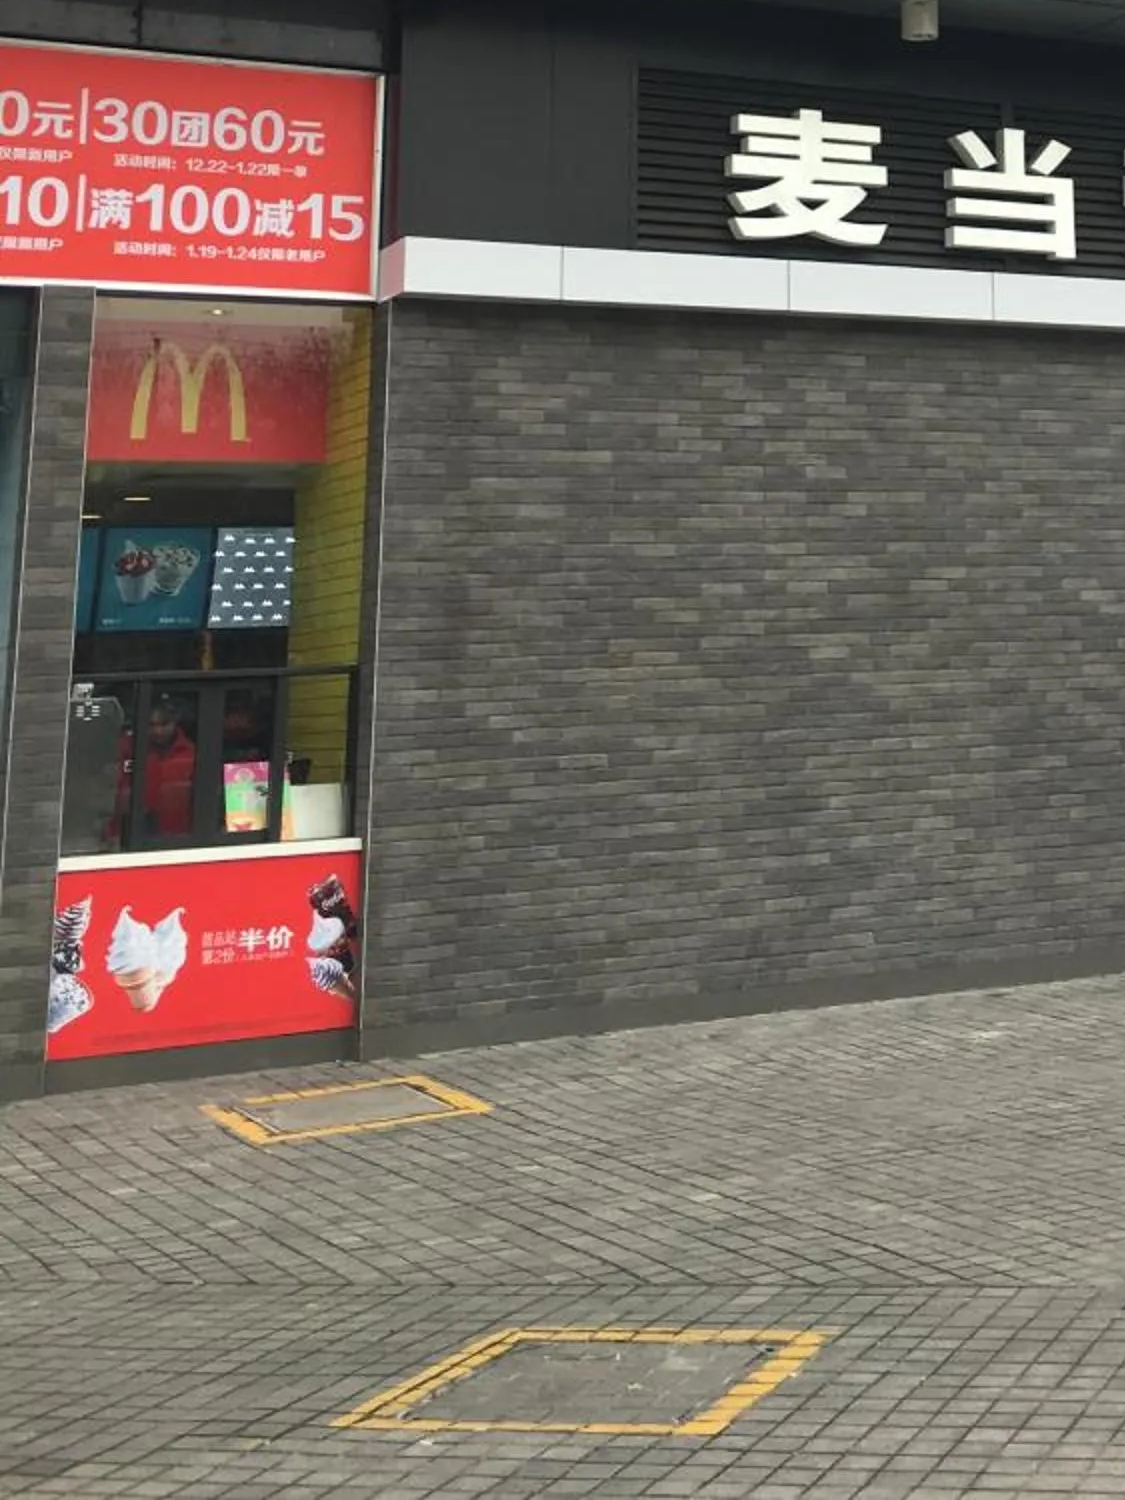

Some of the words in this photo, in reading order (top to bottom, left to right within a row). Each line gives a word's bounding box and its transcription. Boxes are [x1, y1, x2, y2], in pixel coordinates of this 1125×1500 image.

[93, 98, 326, 156] 30团60元
[89, 184, 366, 243] 满100减15
[238, 925, 294, 952] 半价
